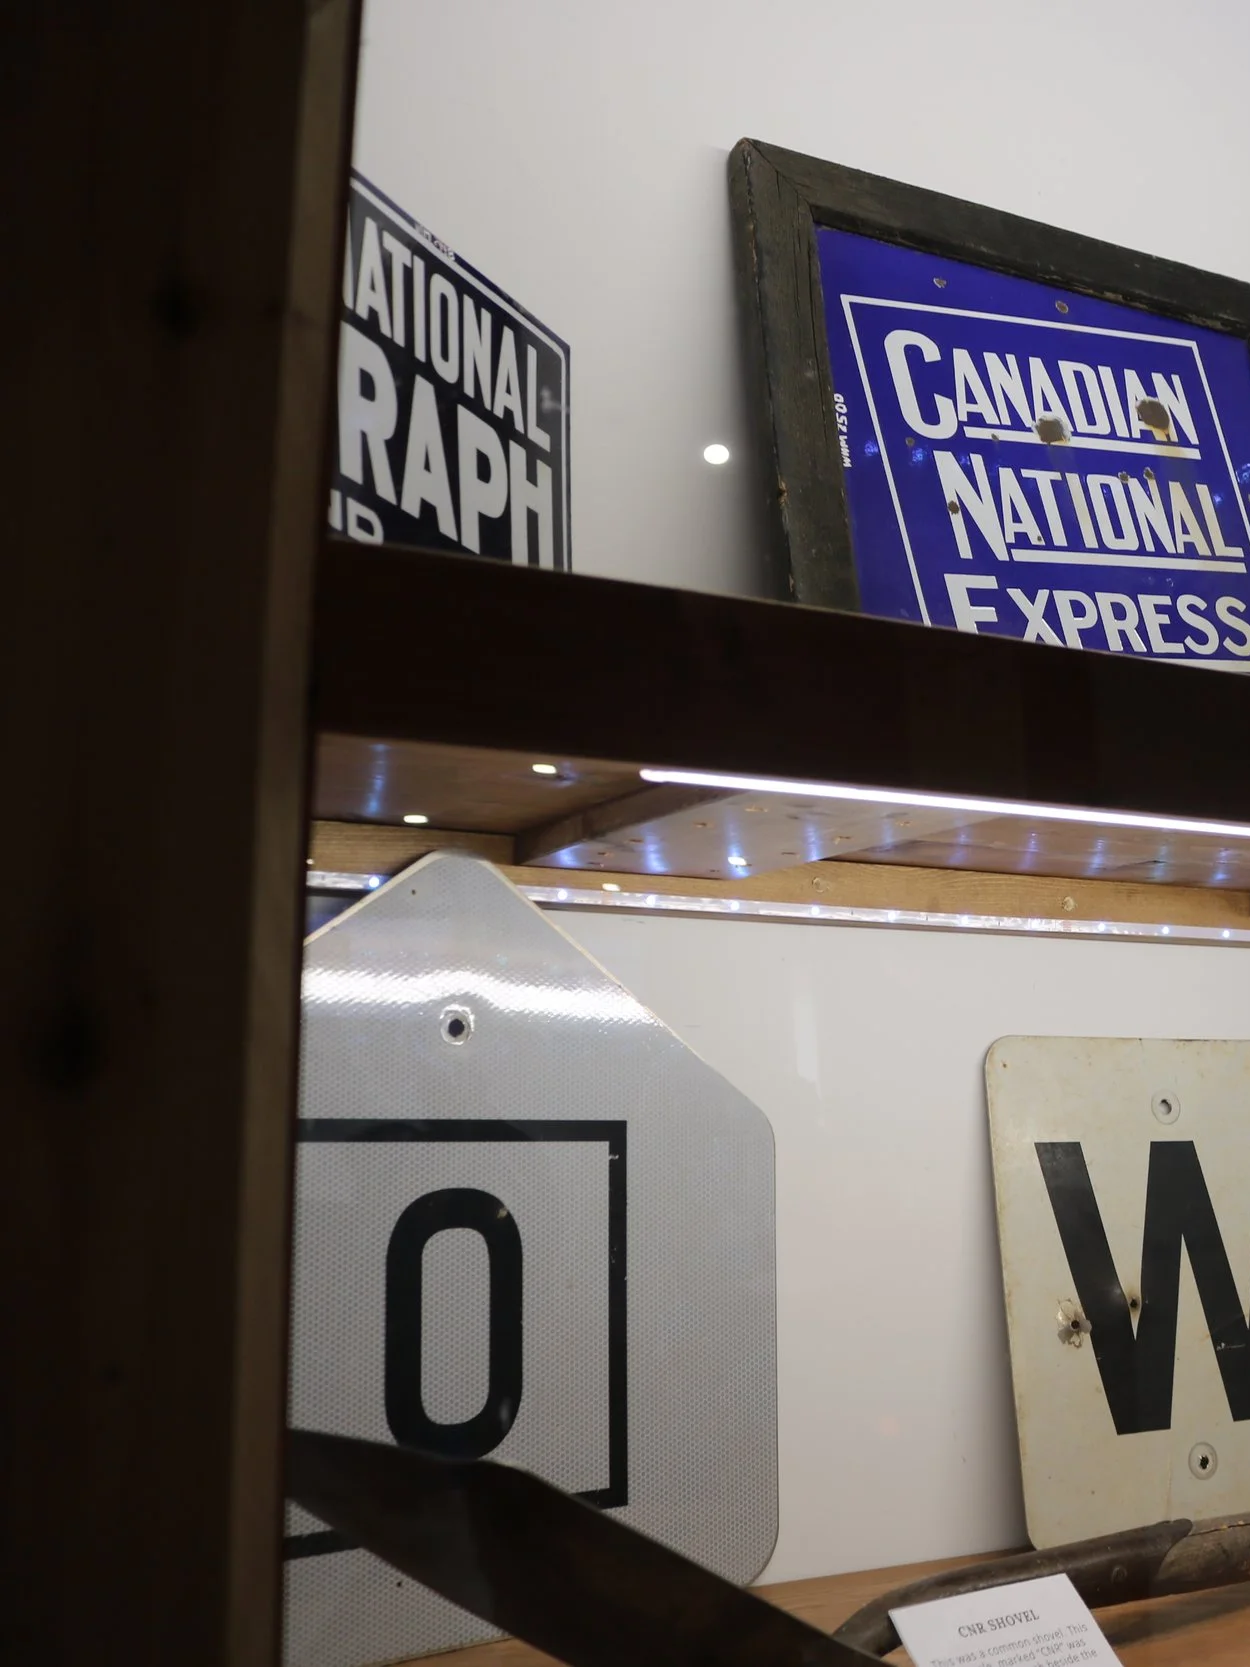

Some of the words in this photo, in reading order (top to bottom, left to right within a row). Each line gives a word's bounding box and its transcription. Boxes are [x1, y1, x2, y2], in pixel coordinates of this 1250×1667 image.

[884, 329, 1200, 445] CANADIAN
[932, 450, 1245, 562] NATIONAL
[958, 1622, 987, 1638] CNR
[987, 1609, 1040, 1631] SHOVEL
[987, 1638, 1031, 1657] common
[1066, 1623, 1088, 1636] This
